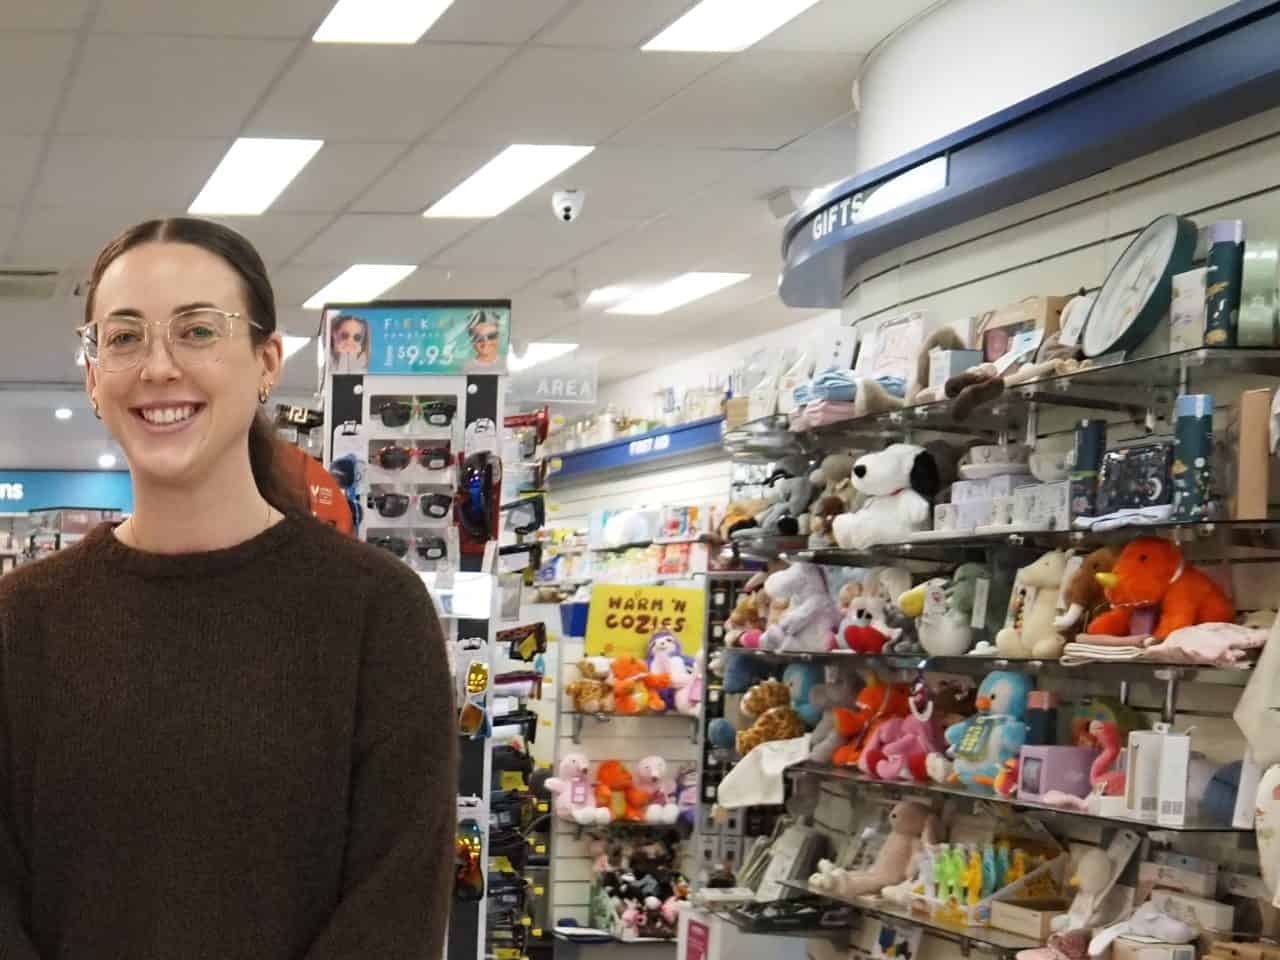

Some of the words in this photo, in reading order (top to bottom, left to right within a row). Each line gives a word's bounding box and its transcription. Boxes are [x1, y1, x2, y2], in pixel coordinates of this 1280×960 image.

[813, 191, 865, 240] GIFTS
[536, 381, 593, 397] AREA
[609, 596, 664, 611] WARM
